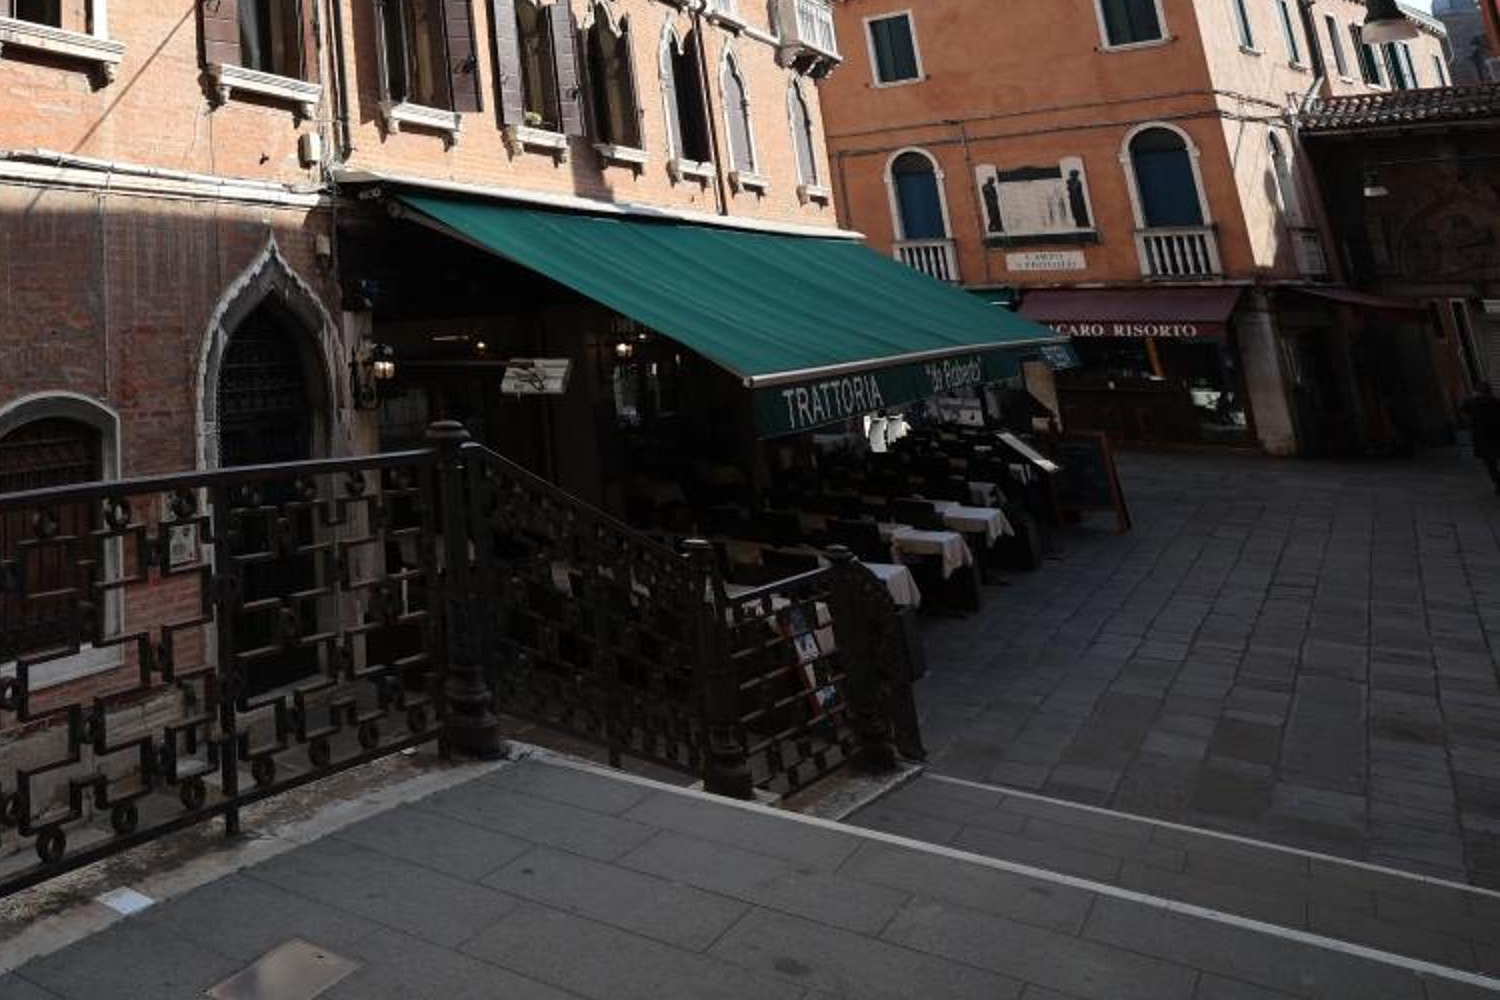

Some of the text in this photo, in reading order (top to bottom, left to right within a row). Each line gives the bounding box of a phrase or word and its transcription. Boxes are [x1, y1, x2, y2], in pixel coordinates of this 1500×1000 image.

[1049, 323, 1197, 337] CARO RISORTO
[782, 375, 884, 428] TRATTORIA
